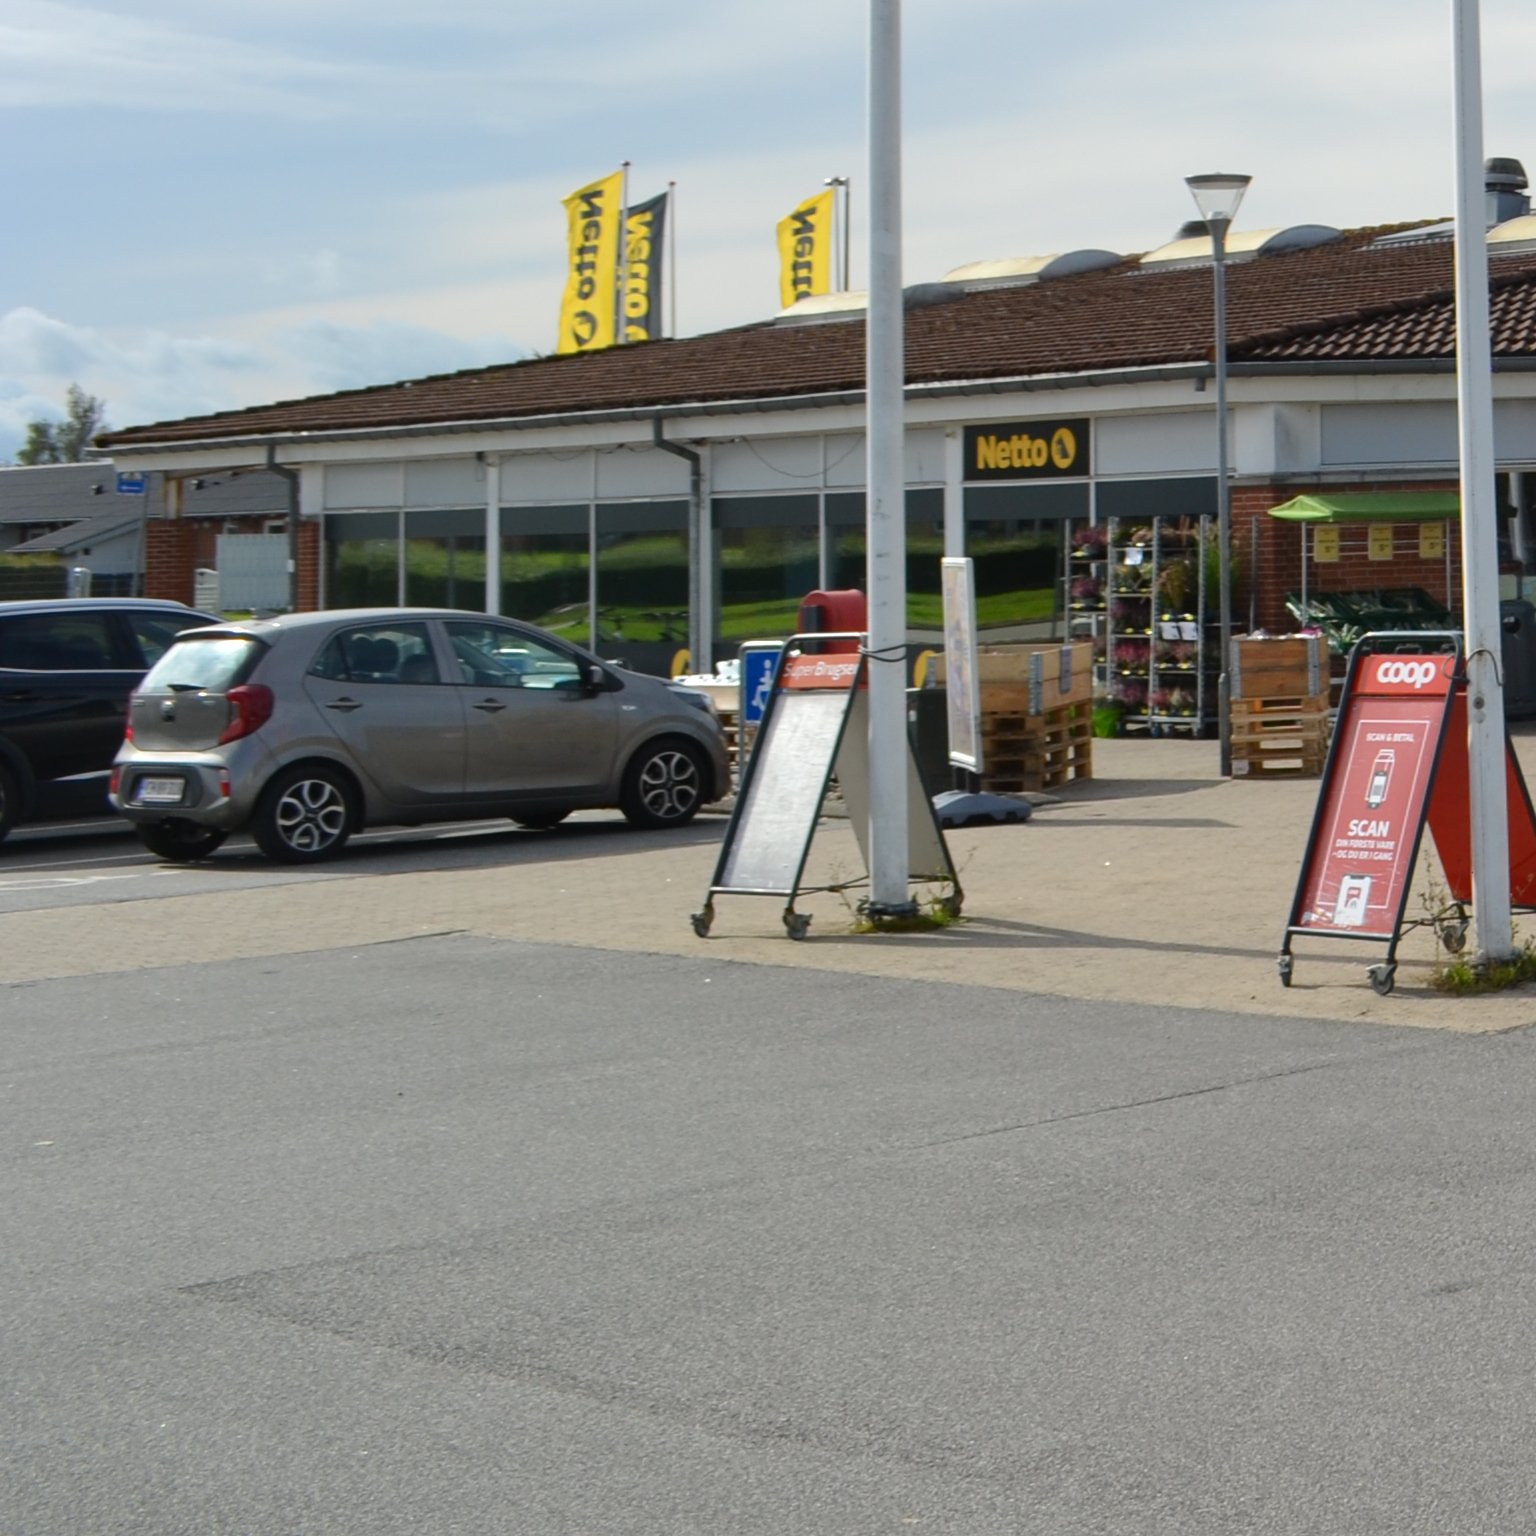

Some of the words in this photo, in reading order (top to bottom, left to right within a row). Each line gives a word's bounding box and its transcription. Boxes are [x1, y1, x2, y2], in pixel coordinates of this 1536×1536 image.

[977, 434, 1049, 469] Netto
[1376, 661, 1437, 689] coop
[1347, 819, 1390, 837] SCAN
